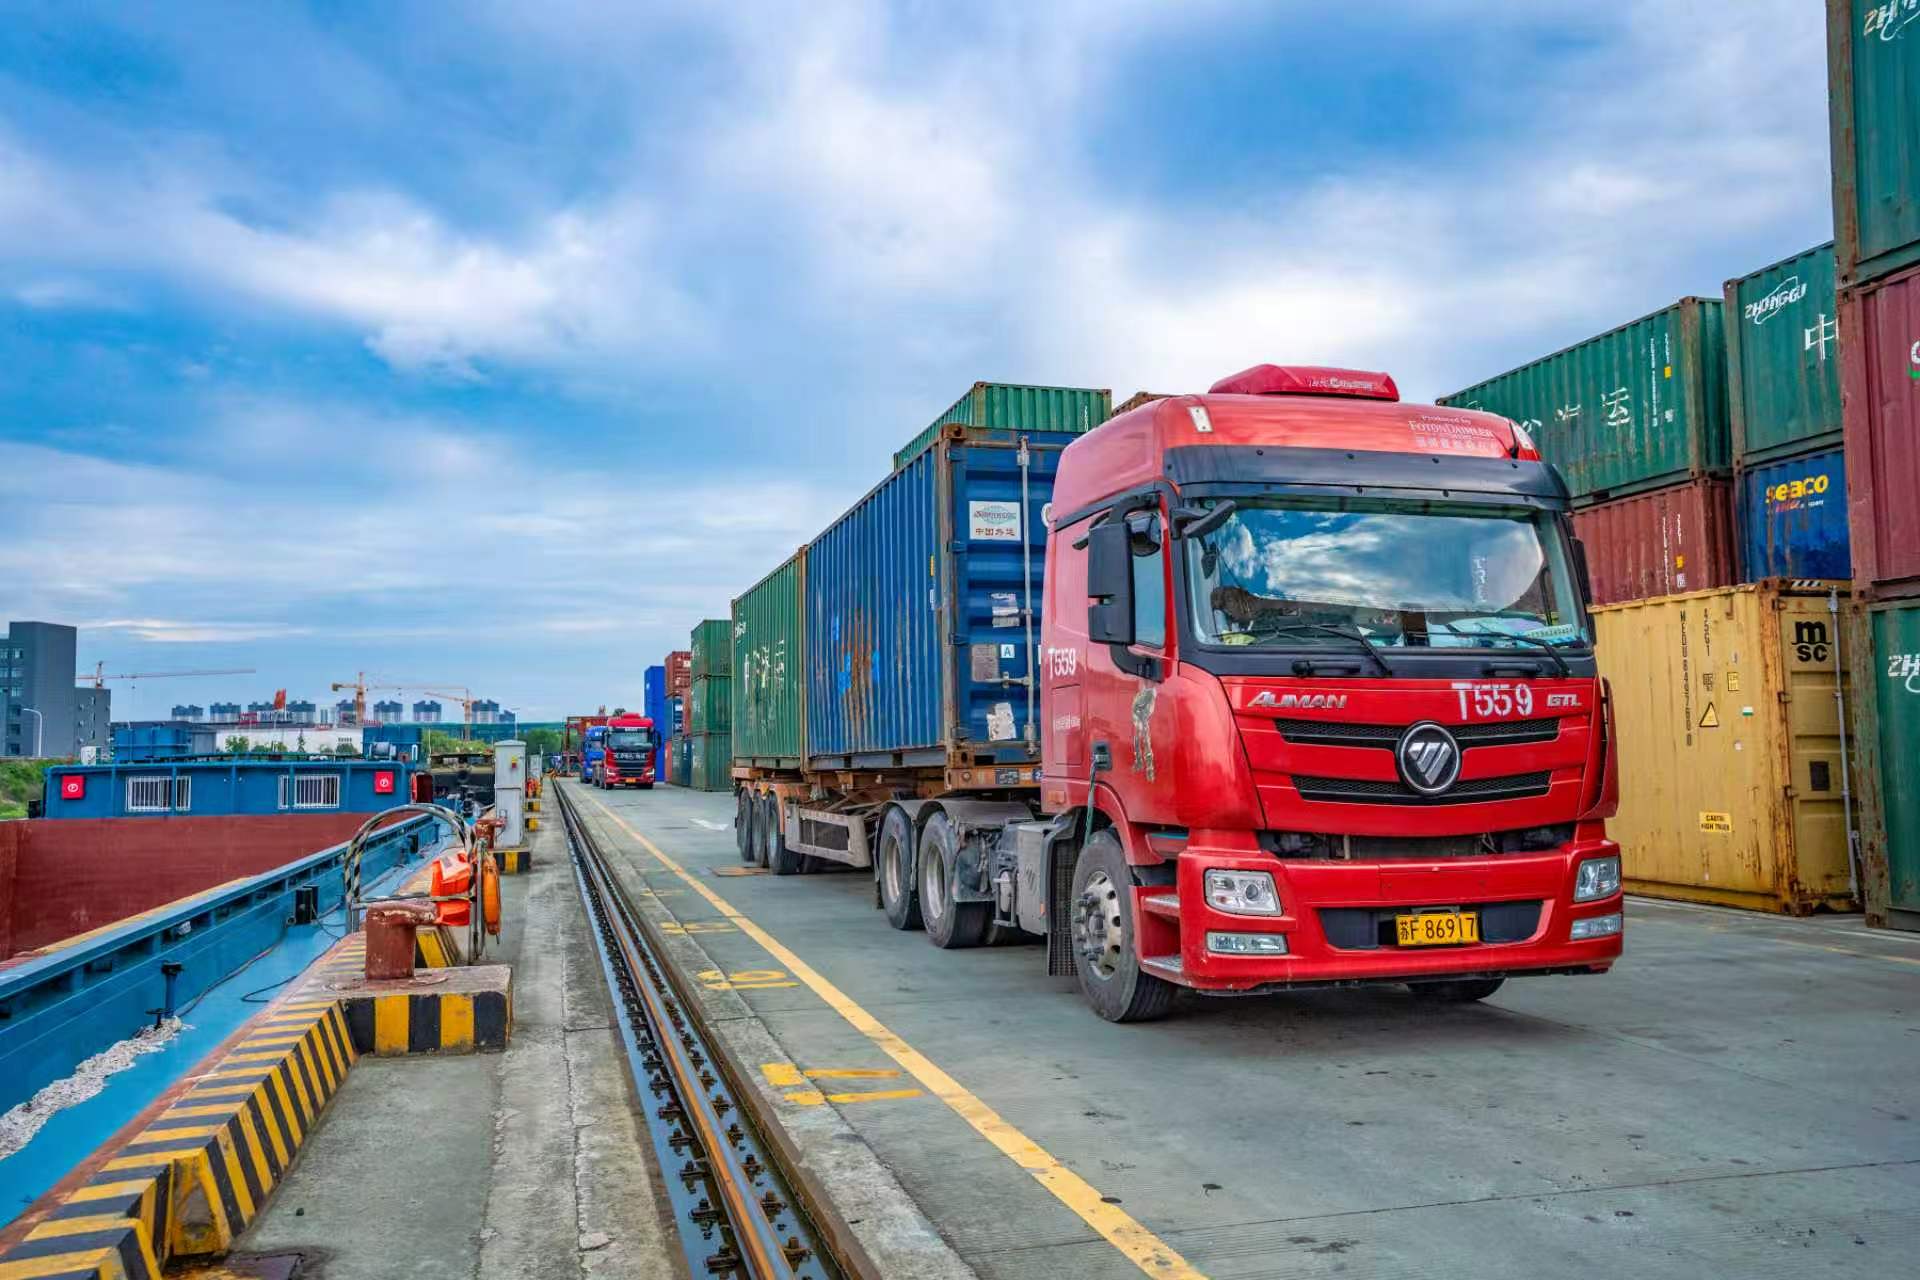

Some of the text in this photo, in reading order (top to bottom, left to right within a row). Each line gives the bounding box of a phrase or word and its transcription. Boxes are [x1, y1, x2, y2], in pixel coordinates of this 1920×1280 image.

[1047, 647, 1076, 680] T559
[1247, 691, 1348, 709] AUMAN
[1451, 682, 1533, 720] T559
[1546, 693, 1582, 707] GTL
